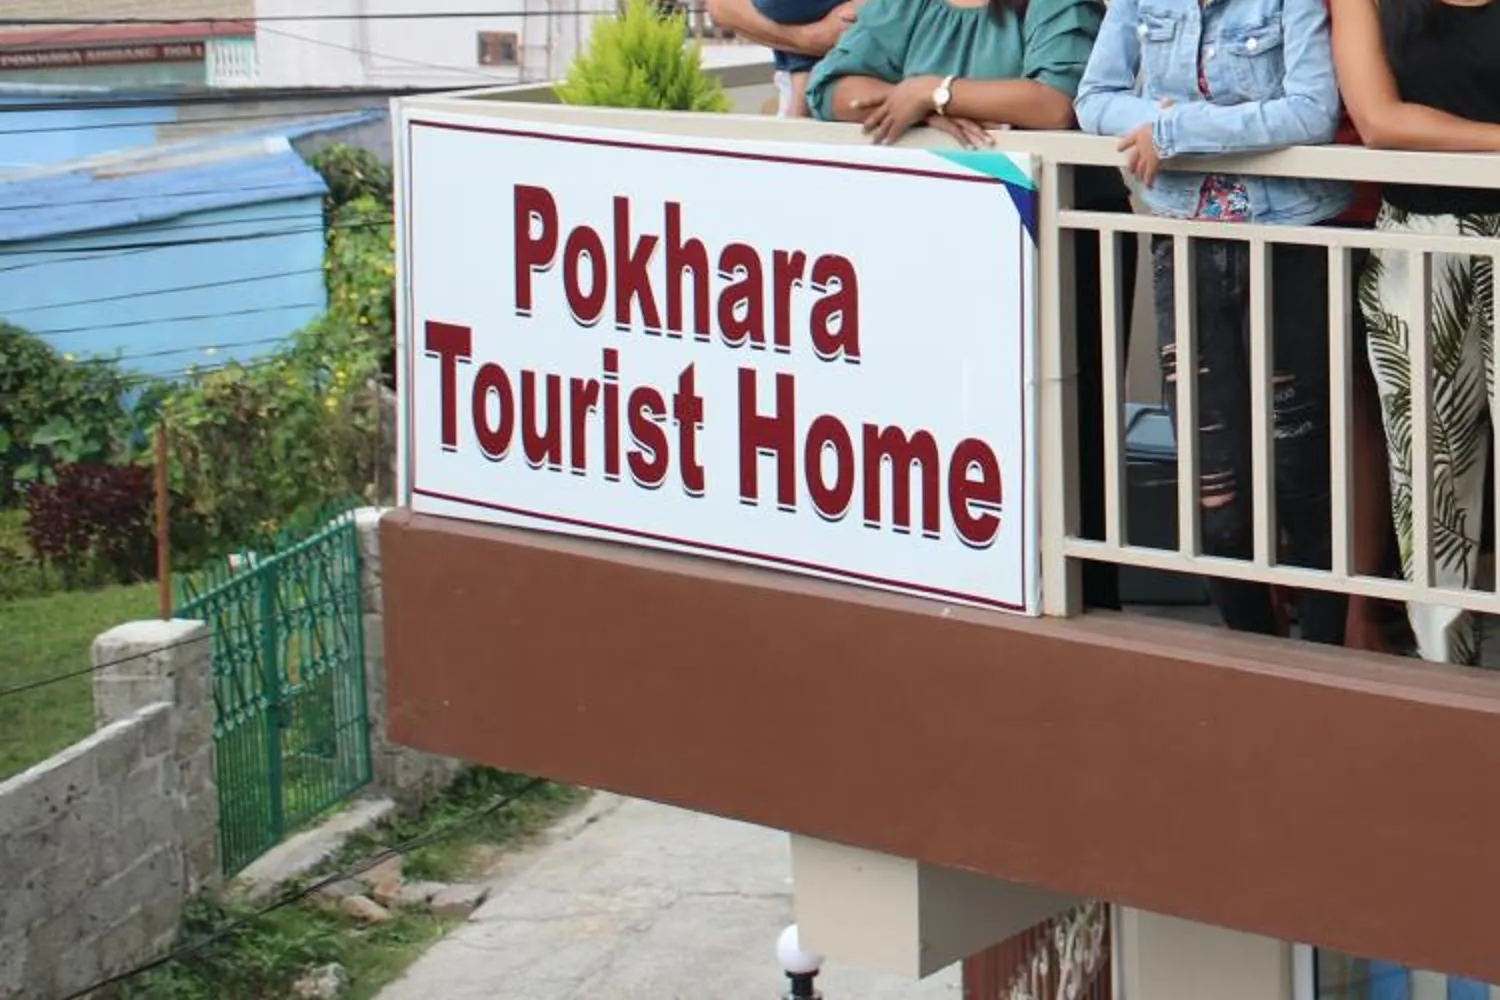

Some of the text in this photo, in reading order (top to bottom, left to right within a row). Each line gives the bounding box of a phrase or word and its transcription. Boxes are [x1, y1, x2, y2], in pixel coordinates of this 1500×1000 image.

[514, 183, 861, 362] Pokhara
[425, 320, 1003, 547] Tourist Home
